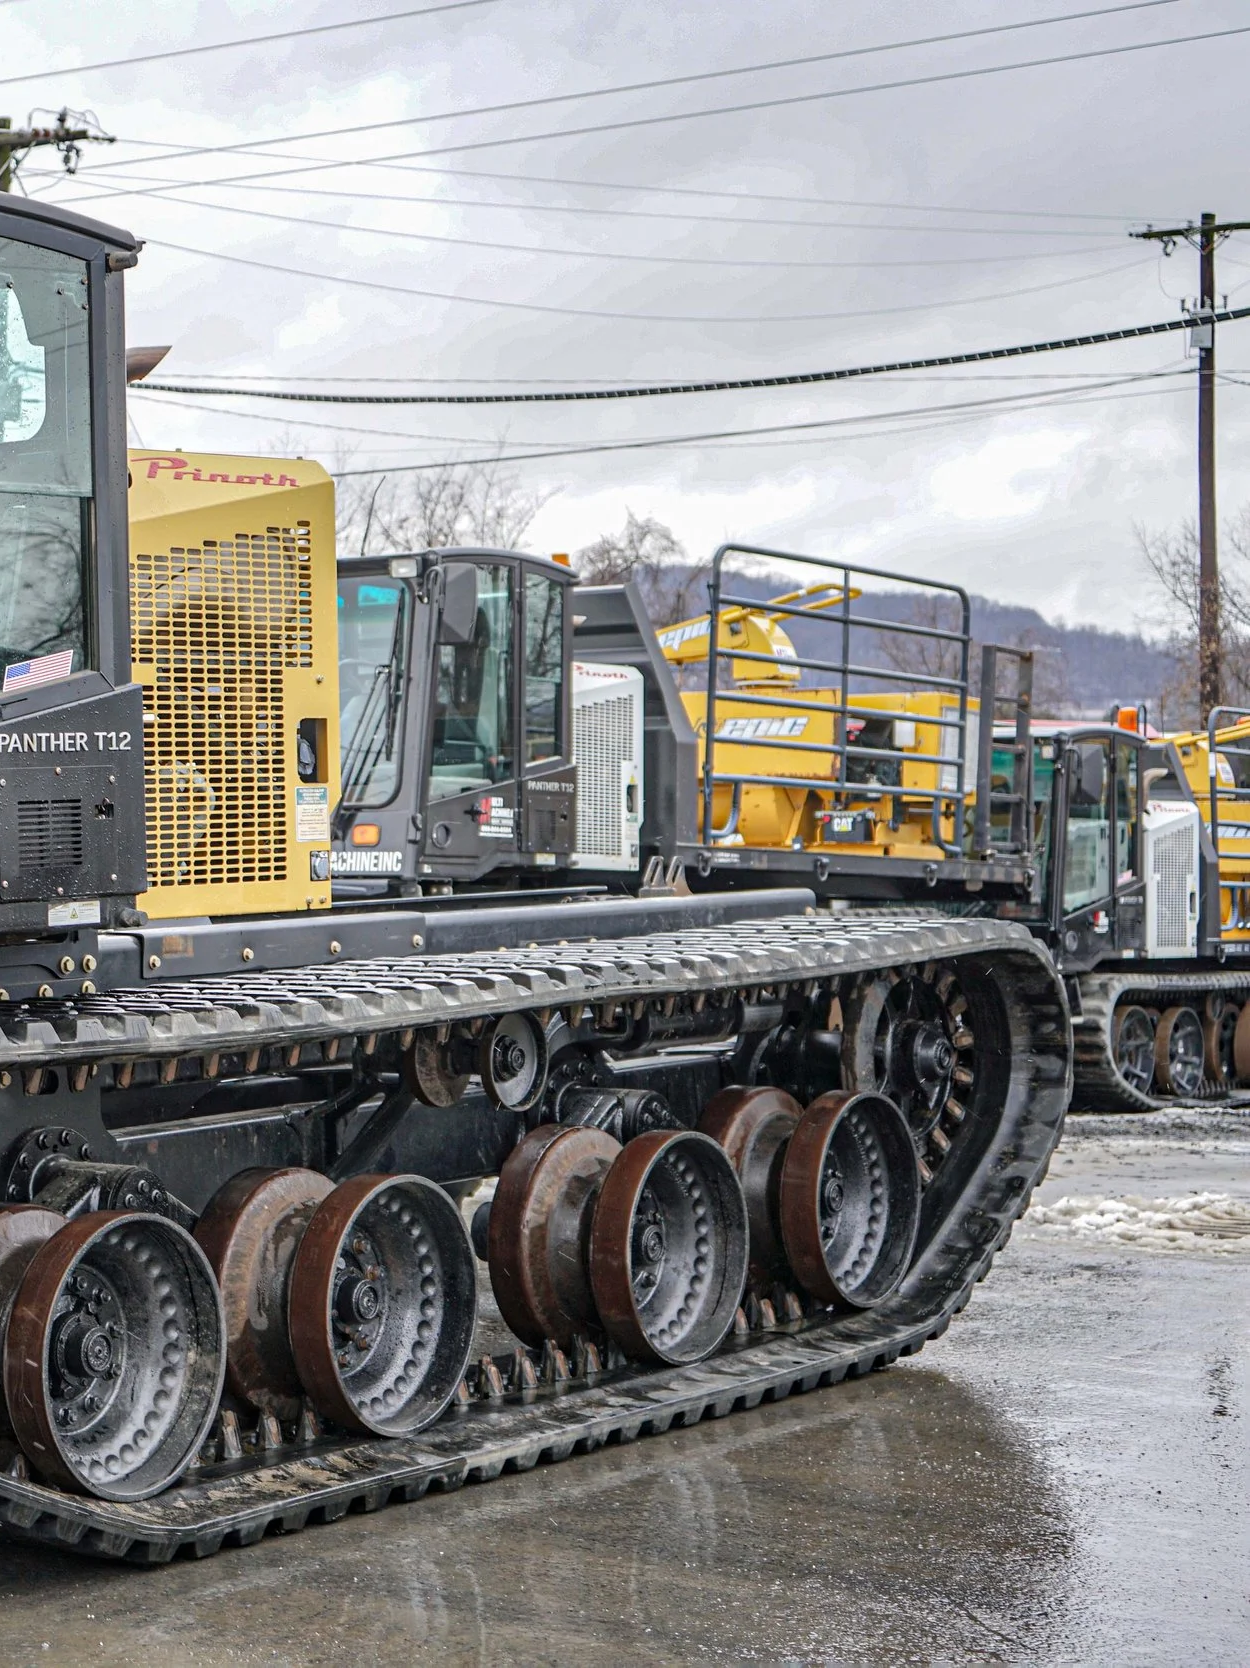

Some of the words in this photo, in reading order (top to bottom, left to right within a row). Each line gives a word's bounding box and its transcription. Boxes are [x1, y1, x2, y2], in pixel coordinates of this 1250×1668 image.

[130, 456, 300, 487] Prinoth
[94, 731, 131, 751] T12
[528, 780, 560, 792] PANTHER
[561, 783, 575, 793] T12
[832, 817, 854, 832] CAT
